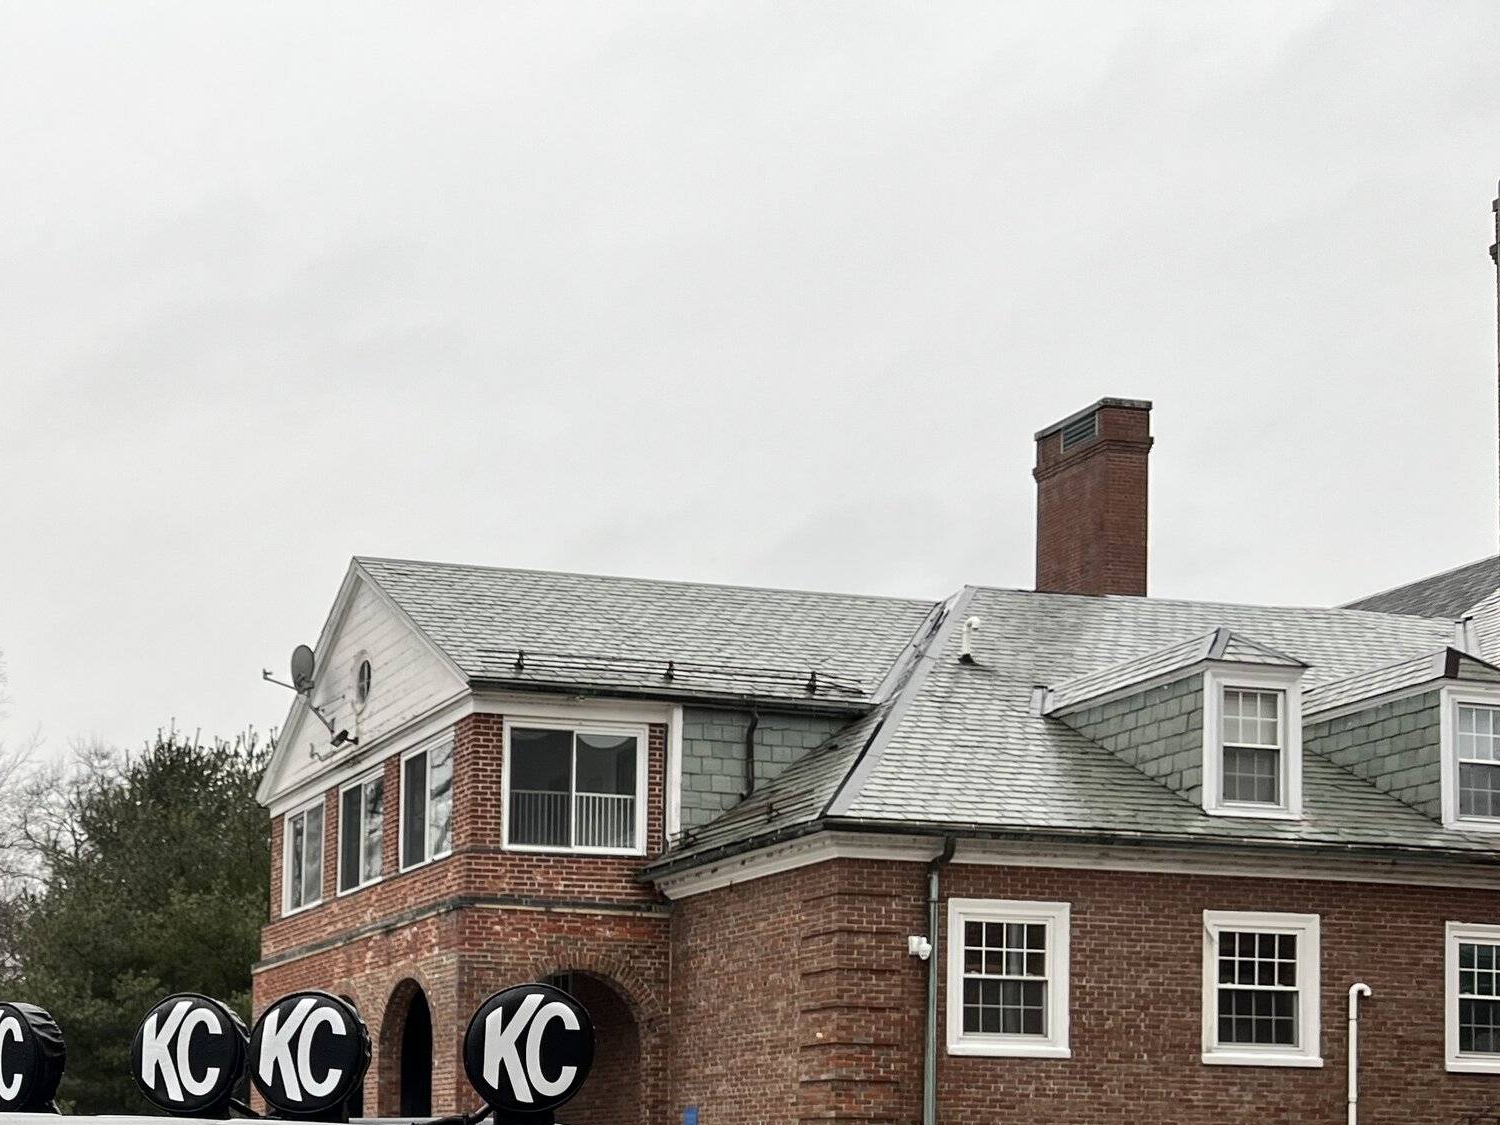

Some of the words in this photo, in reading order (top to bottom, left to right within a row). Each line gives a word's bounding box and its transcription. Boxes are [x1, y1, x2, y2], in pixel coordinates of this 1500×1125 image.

[141, 1000, 223, 1102] KC
[258, 997, 347, 1102] KC
[483, 993, 581, 1103] KC
